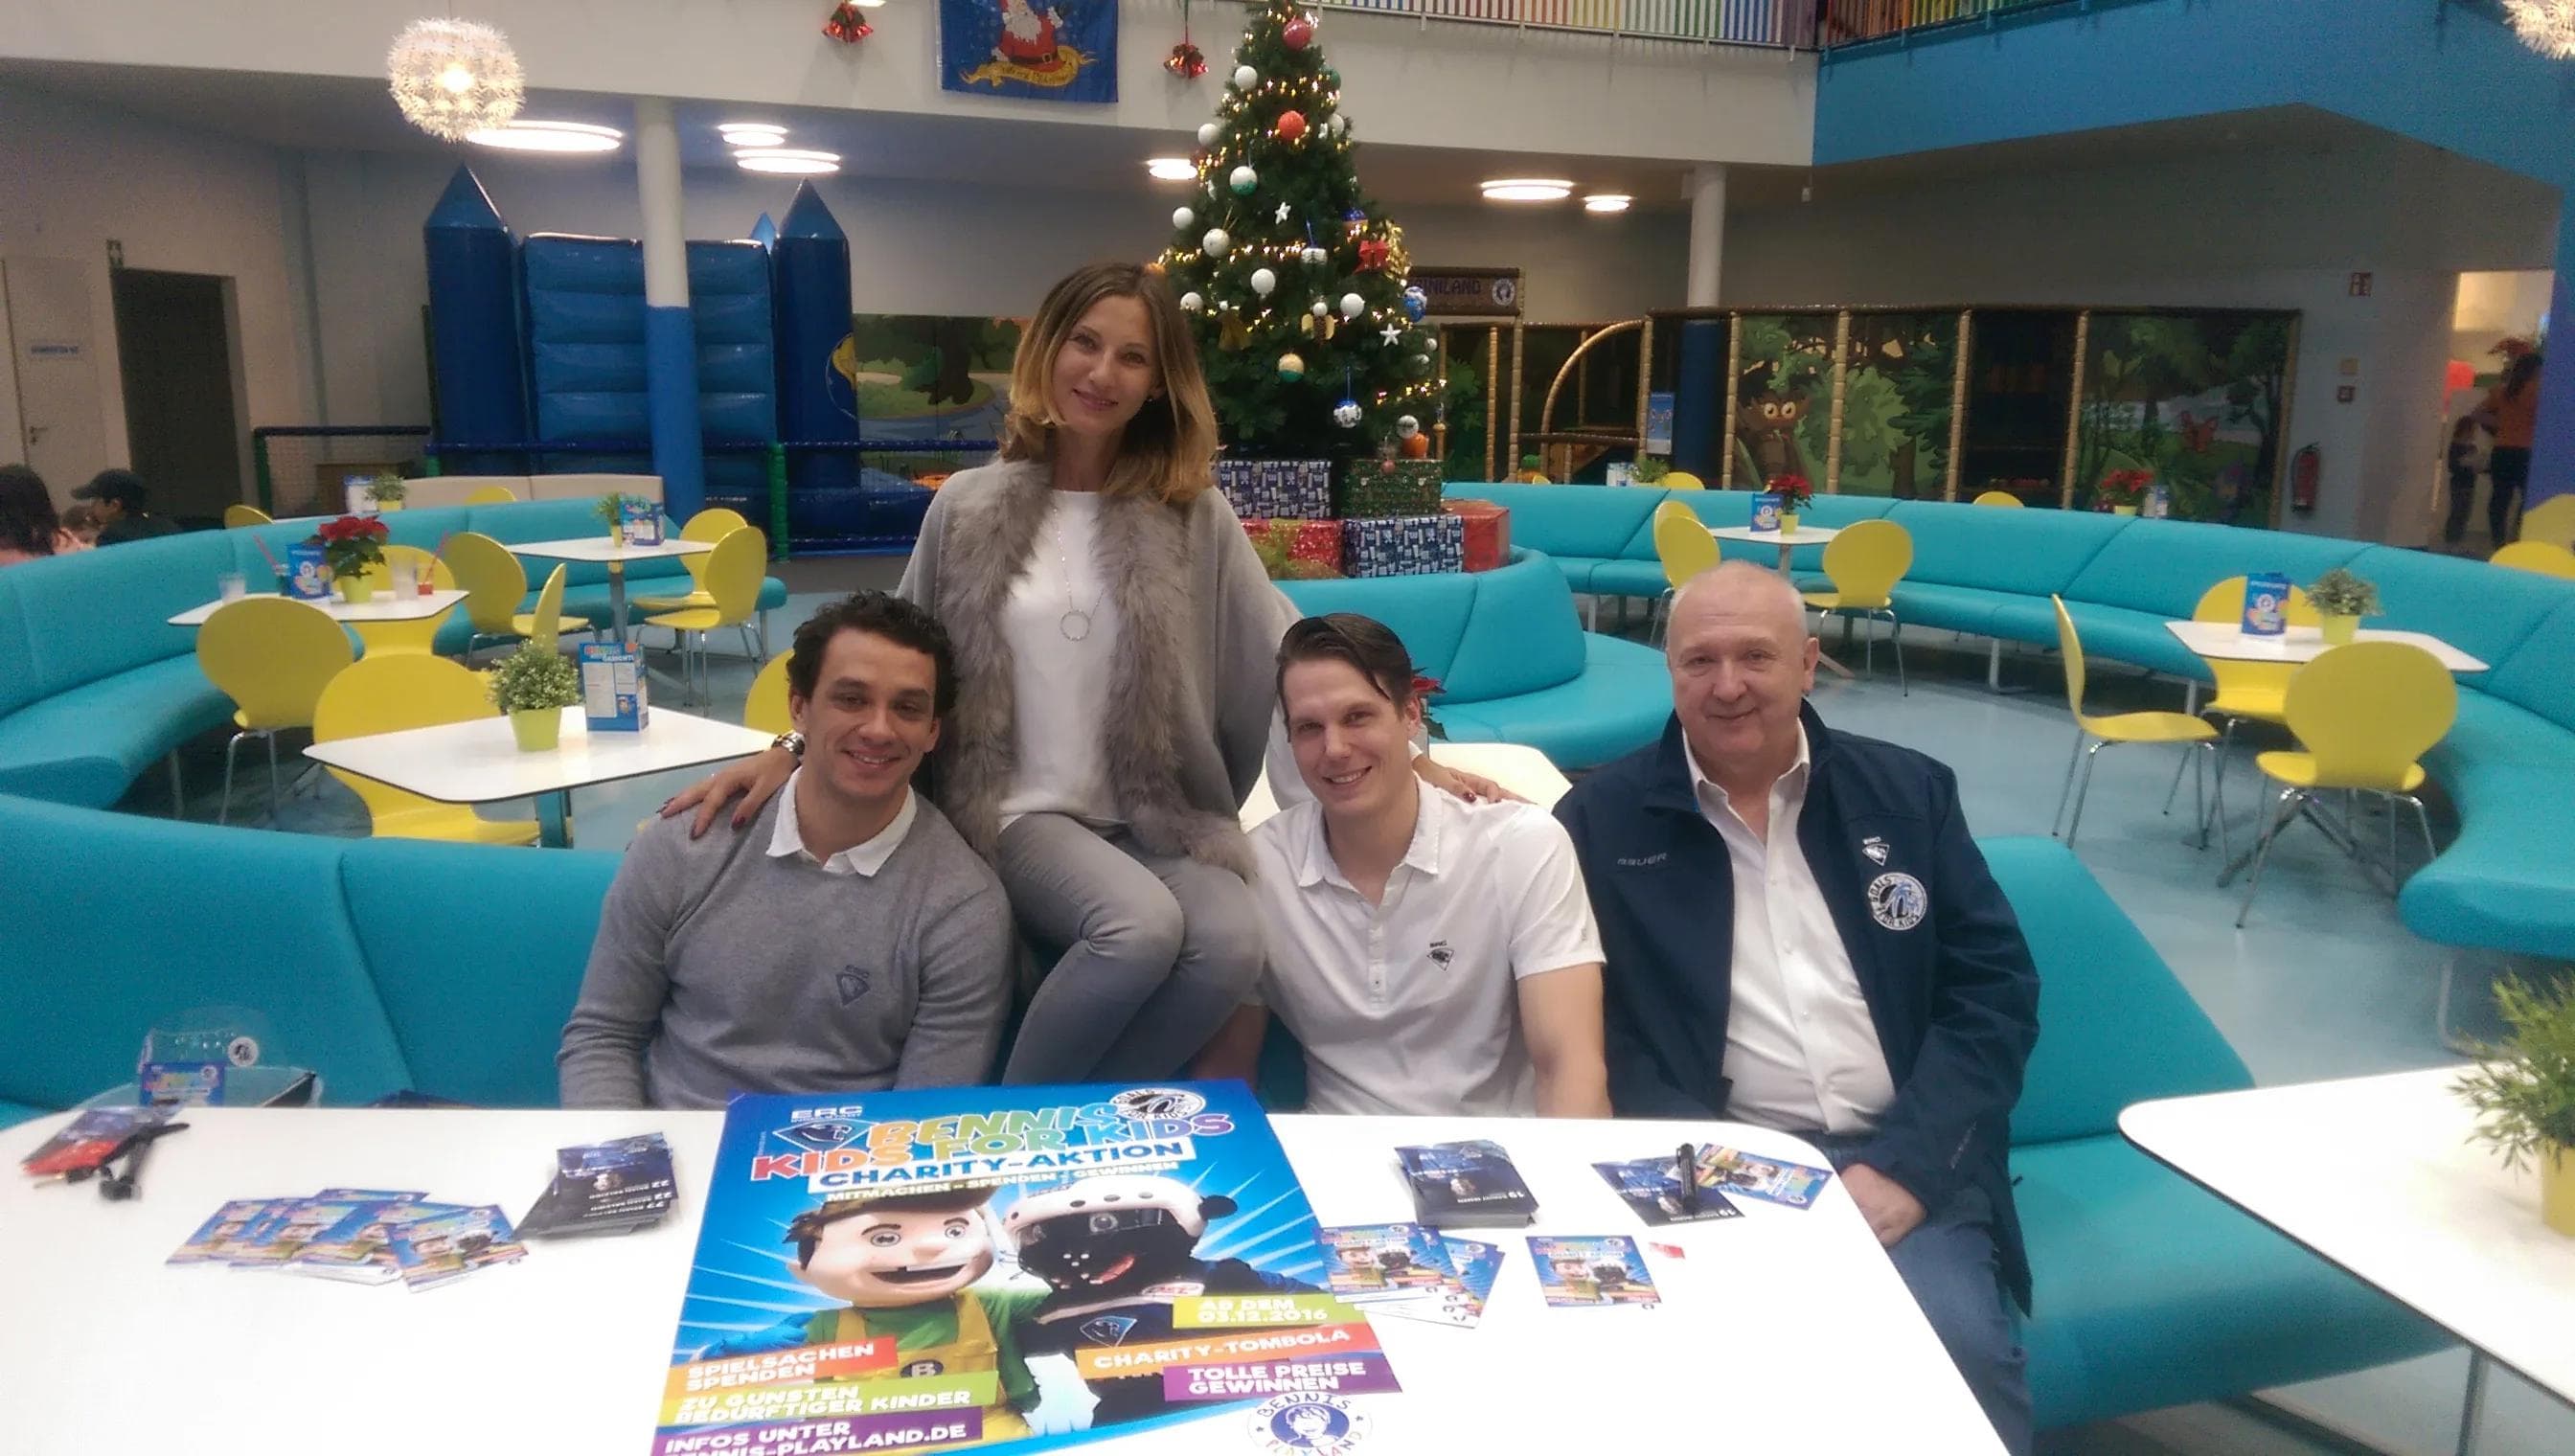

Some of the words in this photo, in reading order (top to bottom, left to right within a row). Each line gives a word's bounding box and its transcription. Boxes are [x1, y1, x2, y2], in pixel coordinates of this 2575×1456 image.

[790, 1105, 863, 1120] ERC
[867, 1102, 1122, 1150] BENNIS
[751, 1145, 913, 1181] KIDS
[933, 1127, 1068, 1164] FOR
[1083, 1114, 1236, 1147] KIDS
[819, 1142, 1184, 1187] CHARITY-AKTION
[826, 1181, 951, 1203] MITMACHEN
[966, 1171, 1058, 1189] SPENDEN
[1072, 1162, 1179, 1179] GEWINNEN
[1197, 1308, 1329, 1324] 03.12.2016
[1198, 1298, 1235, 1311] AB
[688, 1342, 876, 1379] SPIELSACHEN
[1093, 1330, 1351, 1370] CHARITY-TOMBOLA
[686, 1363, 816, 1392] SPENDEN
[1188, 1365, 1269, 1381] TOLLE
[1275, 1361, 1367, 1378] PREISE
[725, 1385, 859, 1408] GUNSTEN
[1188, 1376, 1340, 1395] GEWINNEN
[870, 1390, 971, 1411] KINDER
[1257, 1393, 1352, 1418] BENNIS
[665, 1431, 750, 1454] INFOS
[758, 1422, 852, 1444] UNTER
